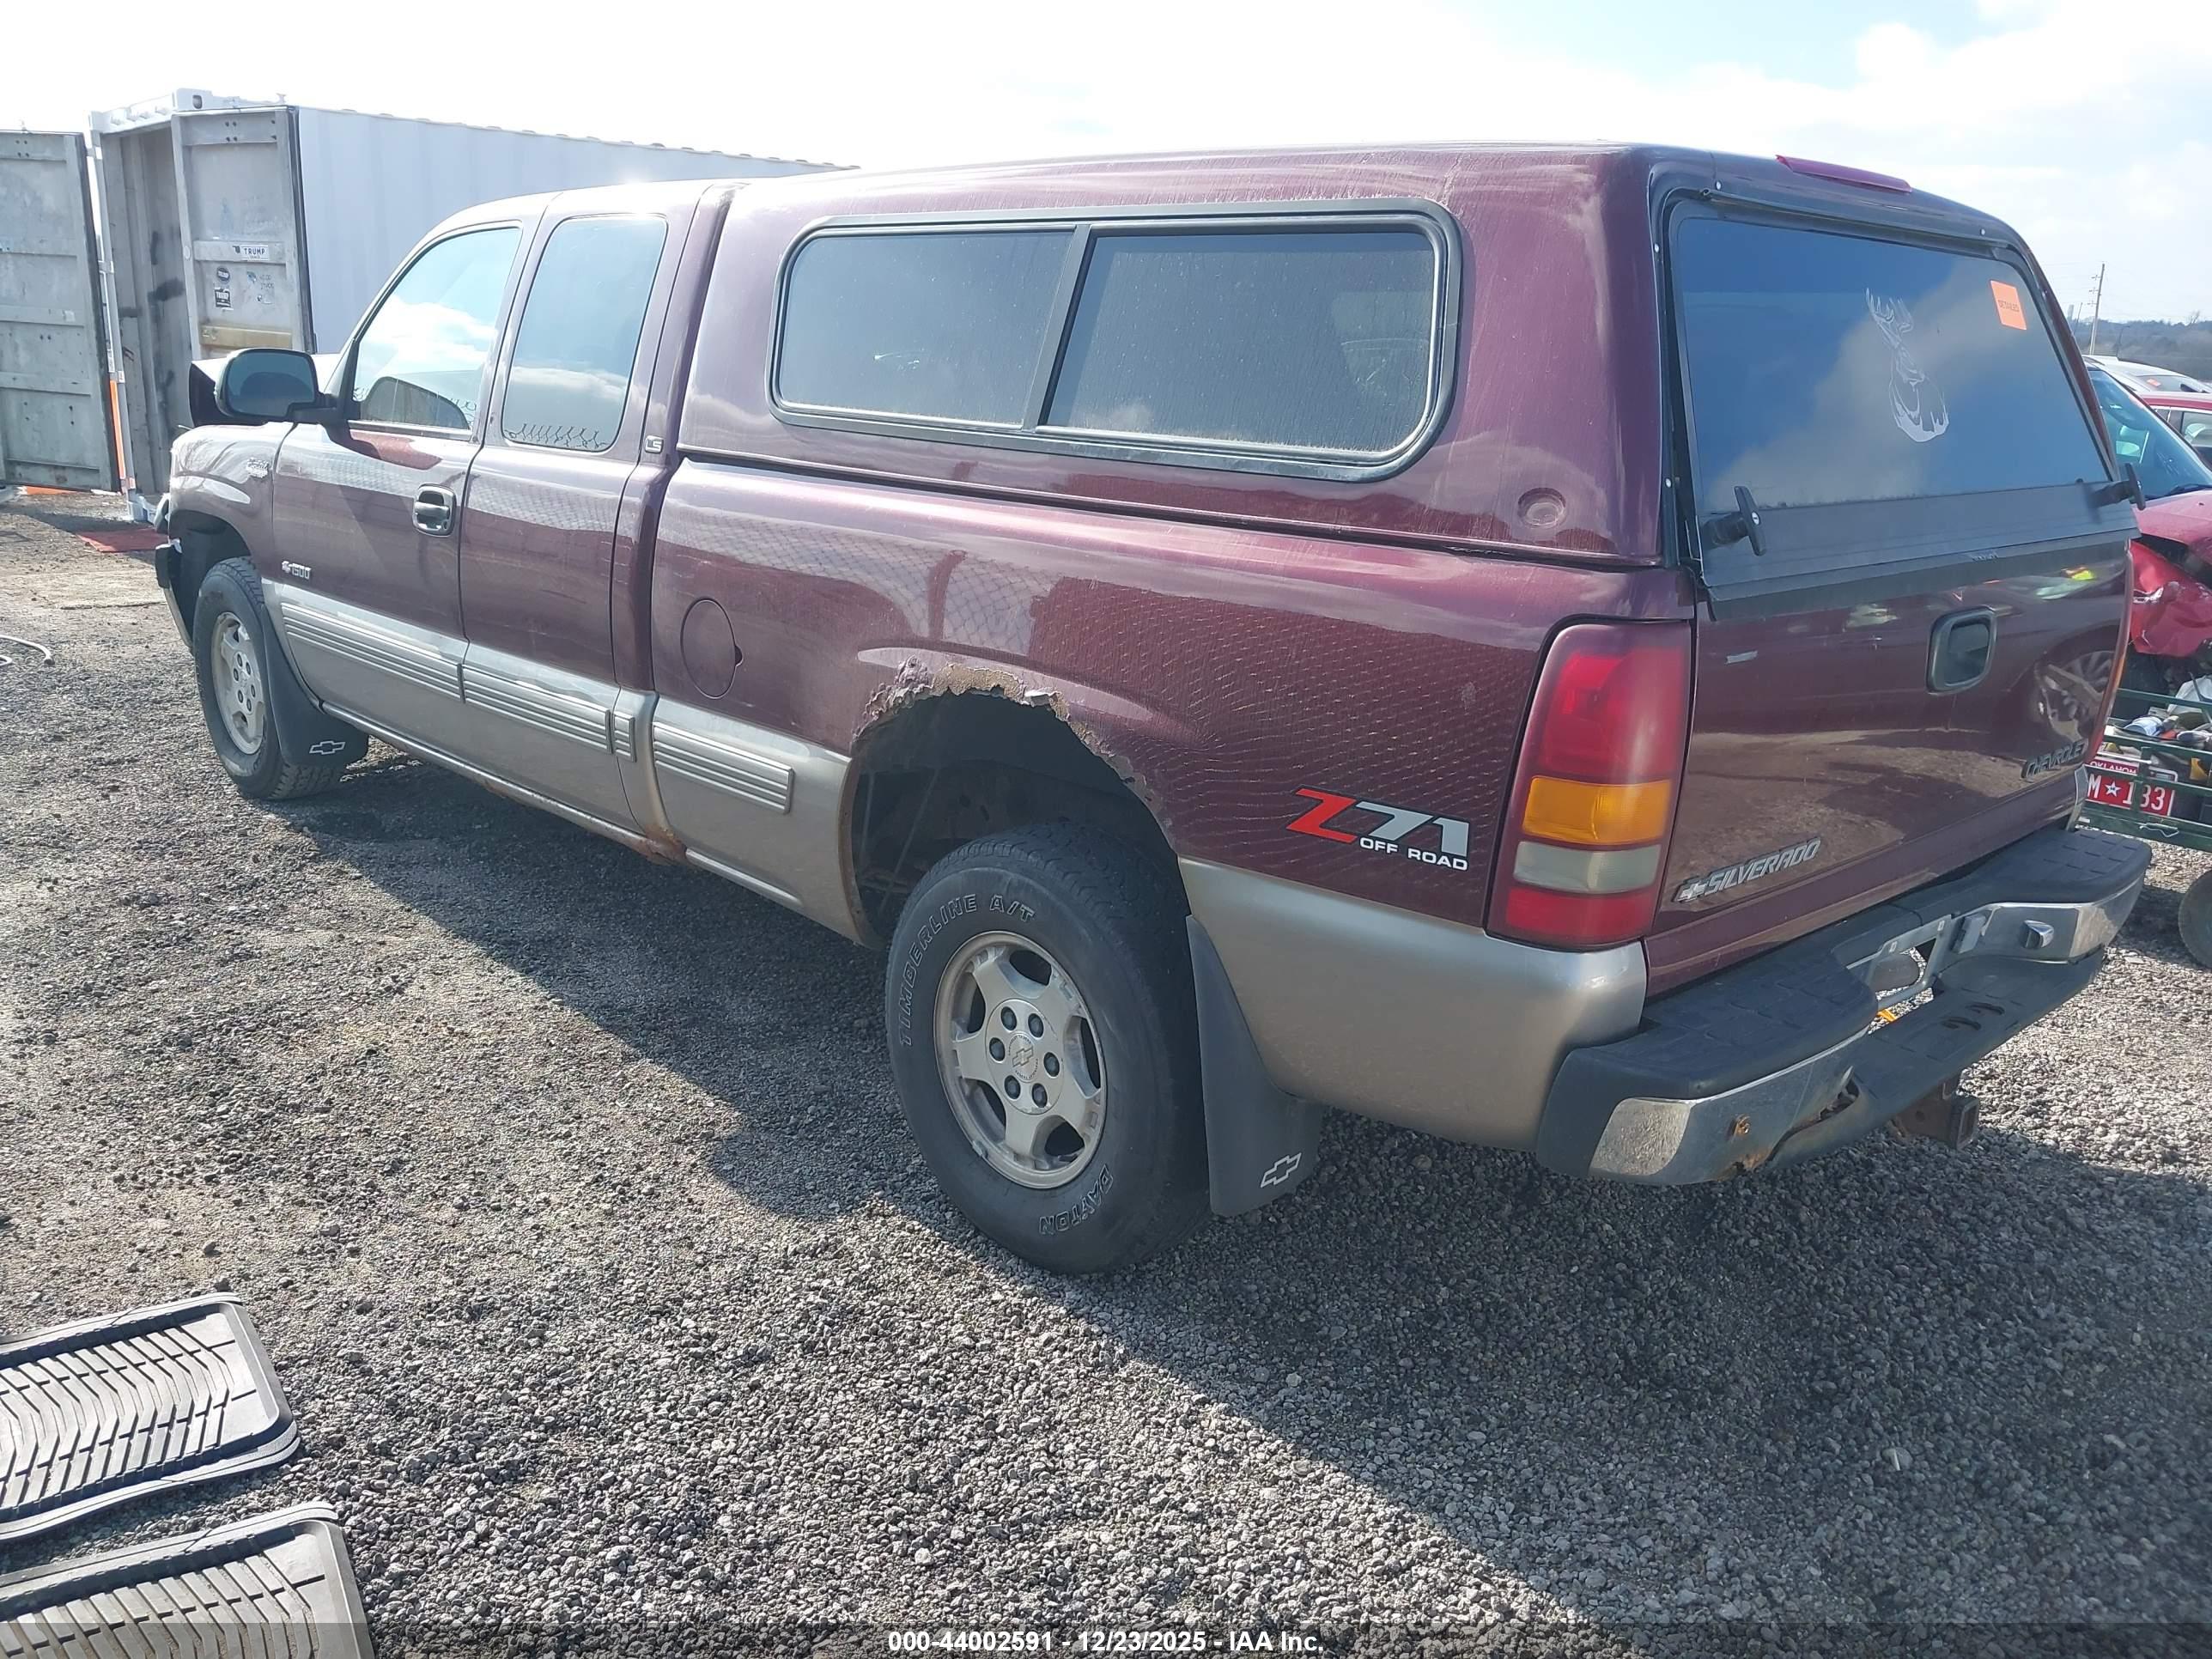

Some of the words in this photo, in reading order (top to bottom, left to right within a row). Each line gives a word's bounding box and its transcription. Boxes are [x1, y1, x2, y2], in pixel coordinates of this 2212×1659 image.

[292, 562, 312, 580] 1500
[1285, 787, 1470, 857] Z71
[1359, 837, 1398, 854] OFF
[1407, 848, 1468, 871] ROAD
[1704, 836, 1821, 896] SILVERADO
[898, 894, 977, 1046] TIMBERLINE
[989, 895, 1035, 921] A/T
[1039, 1164, 1114, 1235] DAYTON
